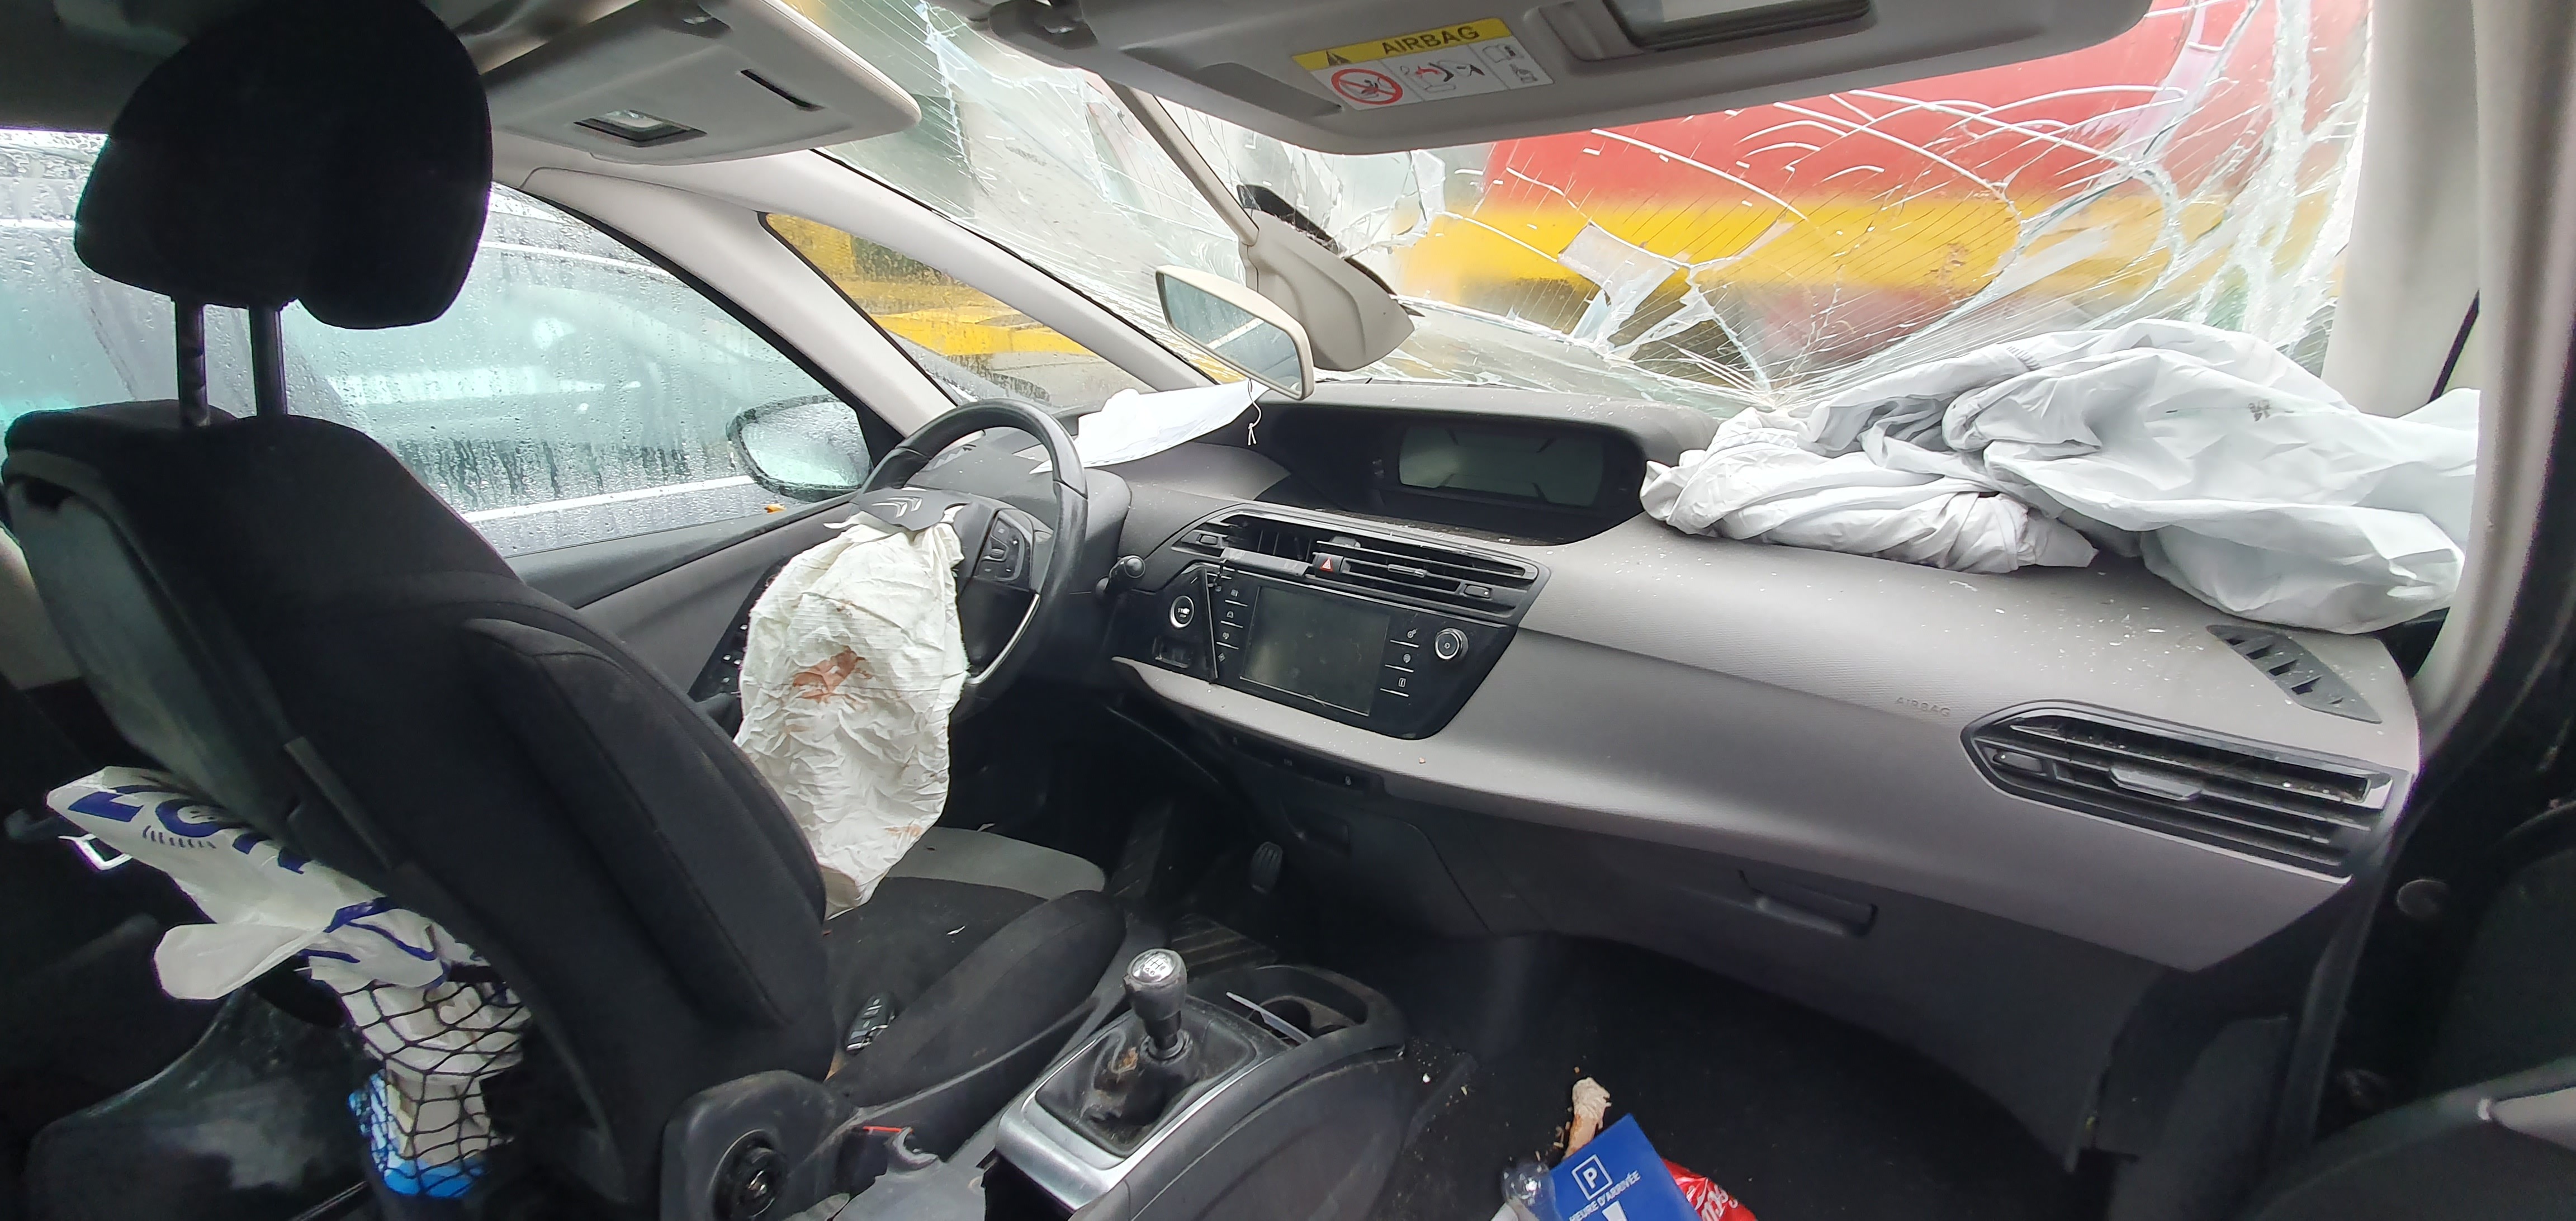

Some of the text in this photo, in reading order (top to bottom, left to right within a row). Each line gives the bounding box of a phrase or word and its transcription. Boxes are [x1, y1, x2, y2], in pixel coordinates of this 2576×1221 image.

[1381, 26, 1480, 56] AIRBAG
[1896, 697, 1951, 717] AIRBAG
[1583, 1167, 1598, 1189] P
[1597, 1170, 1641, 1206] D'ARRIVÉE
